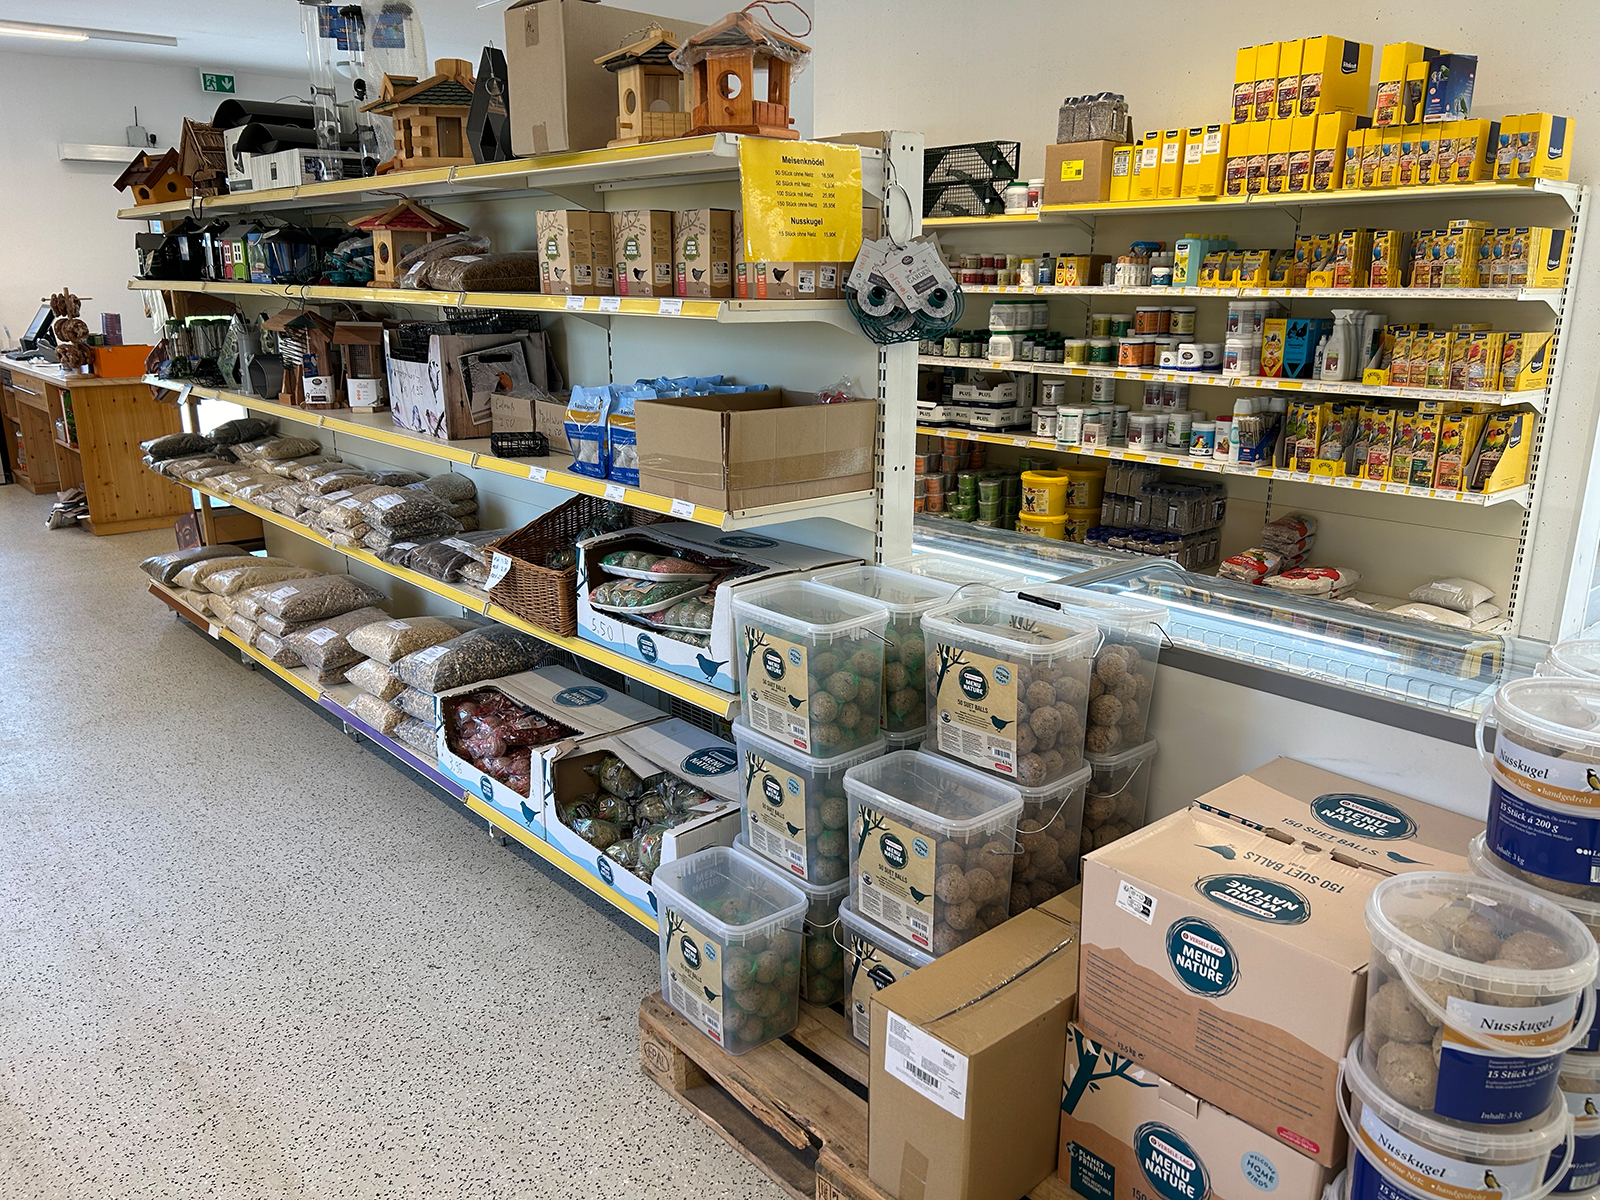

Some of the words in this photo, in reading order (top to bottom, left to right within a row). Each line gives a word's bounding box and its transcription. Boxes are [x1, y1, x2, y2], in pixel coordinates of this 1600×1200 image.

[782, 156, 824, 166] Meisenknödel
[790, 216, 824, 227] Nusskugel
[908, 268, 931, 284] GARDEN
[963, 684, 984, 695] NATURE
[965, 680, 981, 688] MENU
[963, 701, 974, 710] SUET
[975, 705, 988, 714] BALLS
[690, 757, 721, 774] NATURE
[700, 755, 725, 768] MENU
[1500, 748, 1549, 779] Nusskugel
[1518, 779, 1532, 791] Netz
[1542, 788, 1593, 804] handgedreht
[1321, 809, 1389, 836] NATURE
[1335, 806, 1388, 828] MENU
[1500, 802, 1506, 810] 15
[1507, 807, 1527, 821] Stück
[1535, 818, 1551, 829] 200
[1552, 825, 1559, 834] g
[1281, 818, 1303, 828] 150
[1304, 826, 1338, 840] SUET
[1337, 839, 1380, 856] BALLS
[884, 850, 903, 864] NATURE
[886, 845, 901, 856] MENU
[1496, 844, 1512, 858] Inhalt:
[1517, 855, 1525, 866] kg
[1243, 851, 1284, 871] BALLS
[696, 866, 720, 882] MENU
[884, 867, 894, 877] SUET
[895, 872, 908, 884] BALLS
[1284, 868, 1319, 884] SUET
[692, 876, 724, 894] NATURE
[1320, 880, 1345, 894] 150
[1224, 888, 1282, 912] MENU
[1226, 880, 1299, 911] NATURE
[1189, 936, 1223, 955] VERSELE-LAGA
[1183, 944, 1219, 970] MENU
[1176, 954, 1224, 985] NATURE
[1480, 1016, 1554, 1033] Nusskugel
[1117, 1042, 1128, 1053] 13.5
[1129, 1046, 1136, 1057] kg
[1500, 1069, 1527, 1079] Stück
[1536, 1066, 1549, 1075] 200
[1480, 1112, 1506, 1120] Inhalt:
[1514, 1112, 1522, 1120] kg
[1079, 1149, 1104, 1169] PLANET
[1157, 1141, 1193, 1168] VERSELE-LAGA
[1378, 1134, 1446, 1178] Nusskugel
[1079, 1155, 1112, 1180] FRIENDLY
[1151, 1150, 1190, 1182] MENU
[1246, 1160, 1275, 1183] HOME
[1249, 1154, 1276, 1175] WELCOME
[1388, 1159, 1406, 1174] ohne
[1407, 1172, 1425, 1186] Netz
[1145, 1158, 1195, 1198] NATURE
[1246, 1171, 1268, 1189] BIRDS
[1132, 1187, 1147, 1200] 150
[1379, 1184, 1389, 1195] 15
